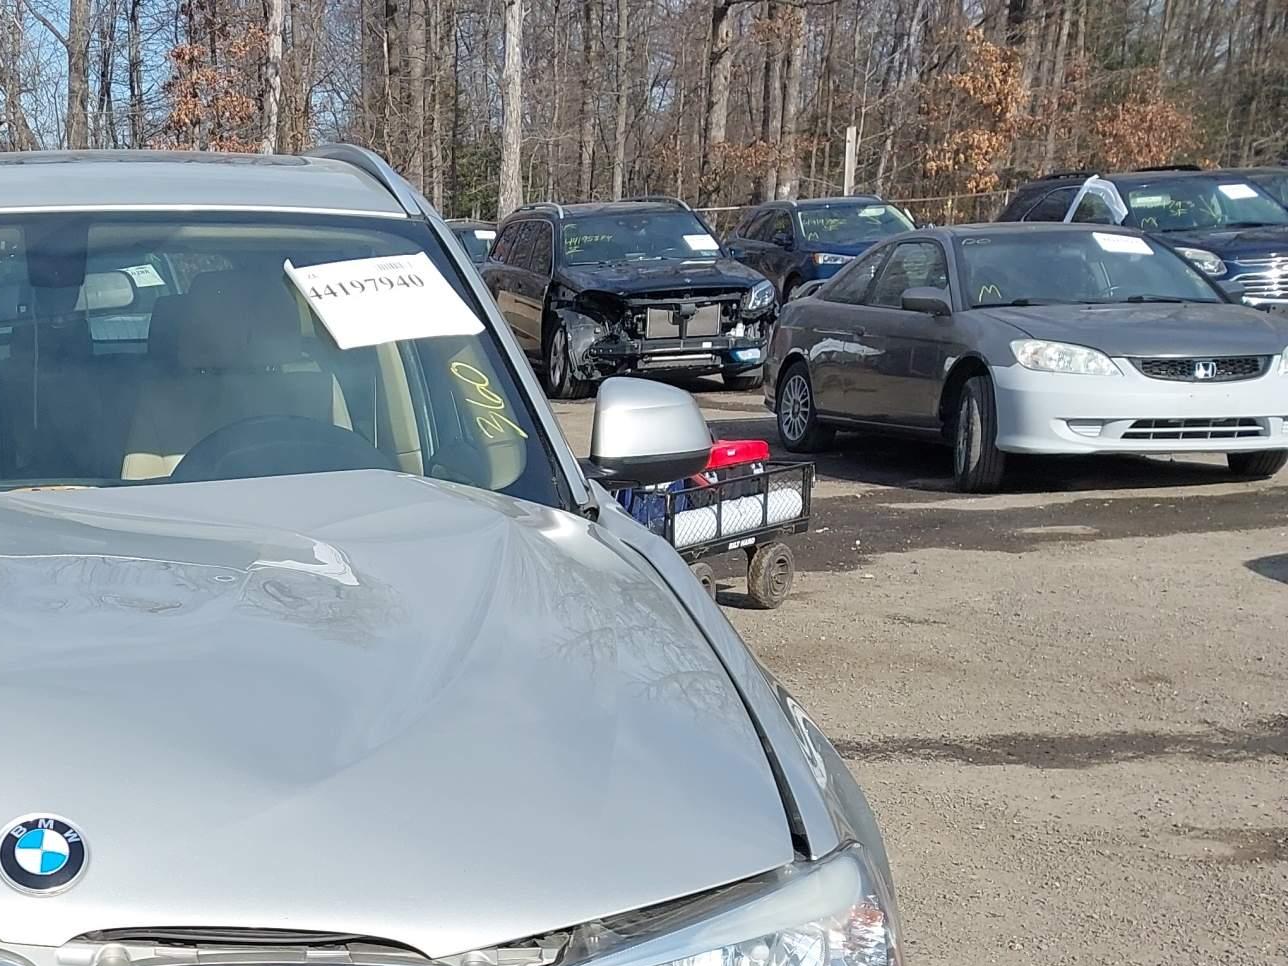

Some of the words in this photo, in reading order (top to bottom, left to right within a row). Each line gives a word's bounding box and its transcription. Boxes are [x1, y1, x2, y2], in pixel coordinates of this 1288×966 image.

[309, 273, 425, 300] 44197940
[979, 285, 1002, 303] M
[450, 361, 529, 439] 360
[10, 818, 81, 843] BMW
